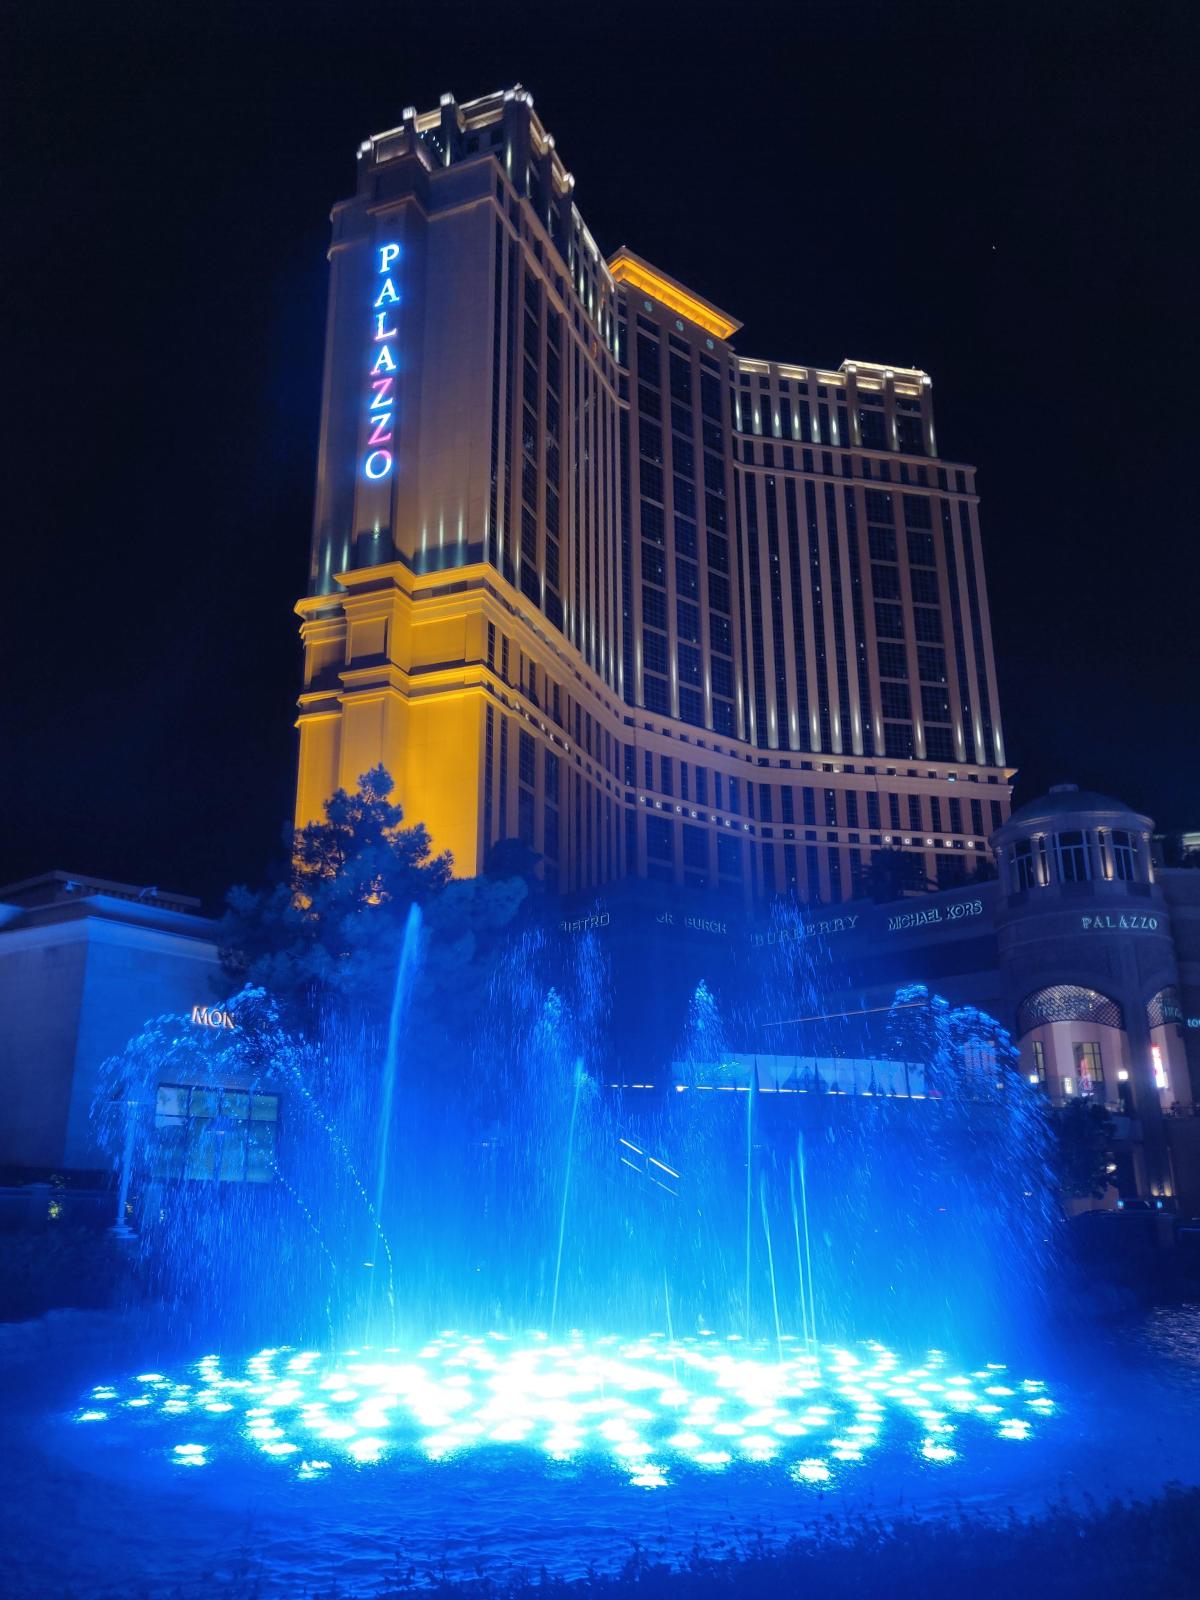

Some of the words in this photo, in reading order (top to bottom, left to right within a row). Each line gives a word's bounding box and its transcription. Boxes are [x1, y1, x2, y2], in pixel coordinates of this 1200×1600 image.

[365, 243, 400, 479] PALAZZO
[888, 908, 943, 931] MICHAEL
[946, 900, 984, 920] KORS
[1081, 915, 1158, 930] PALAZZO
